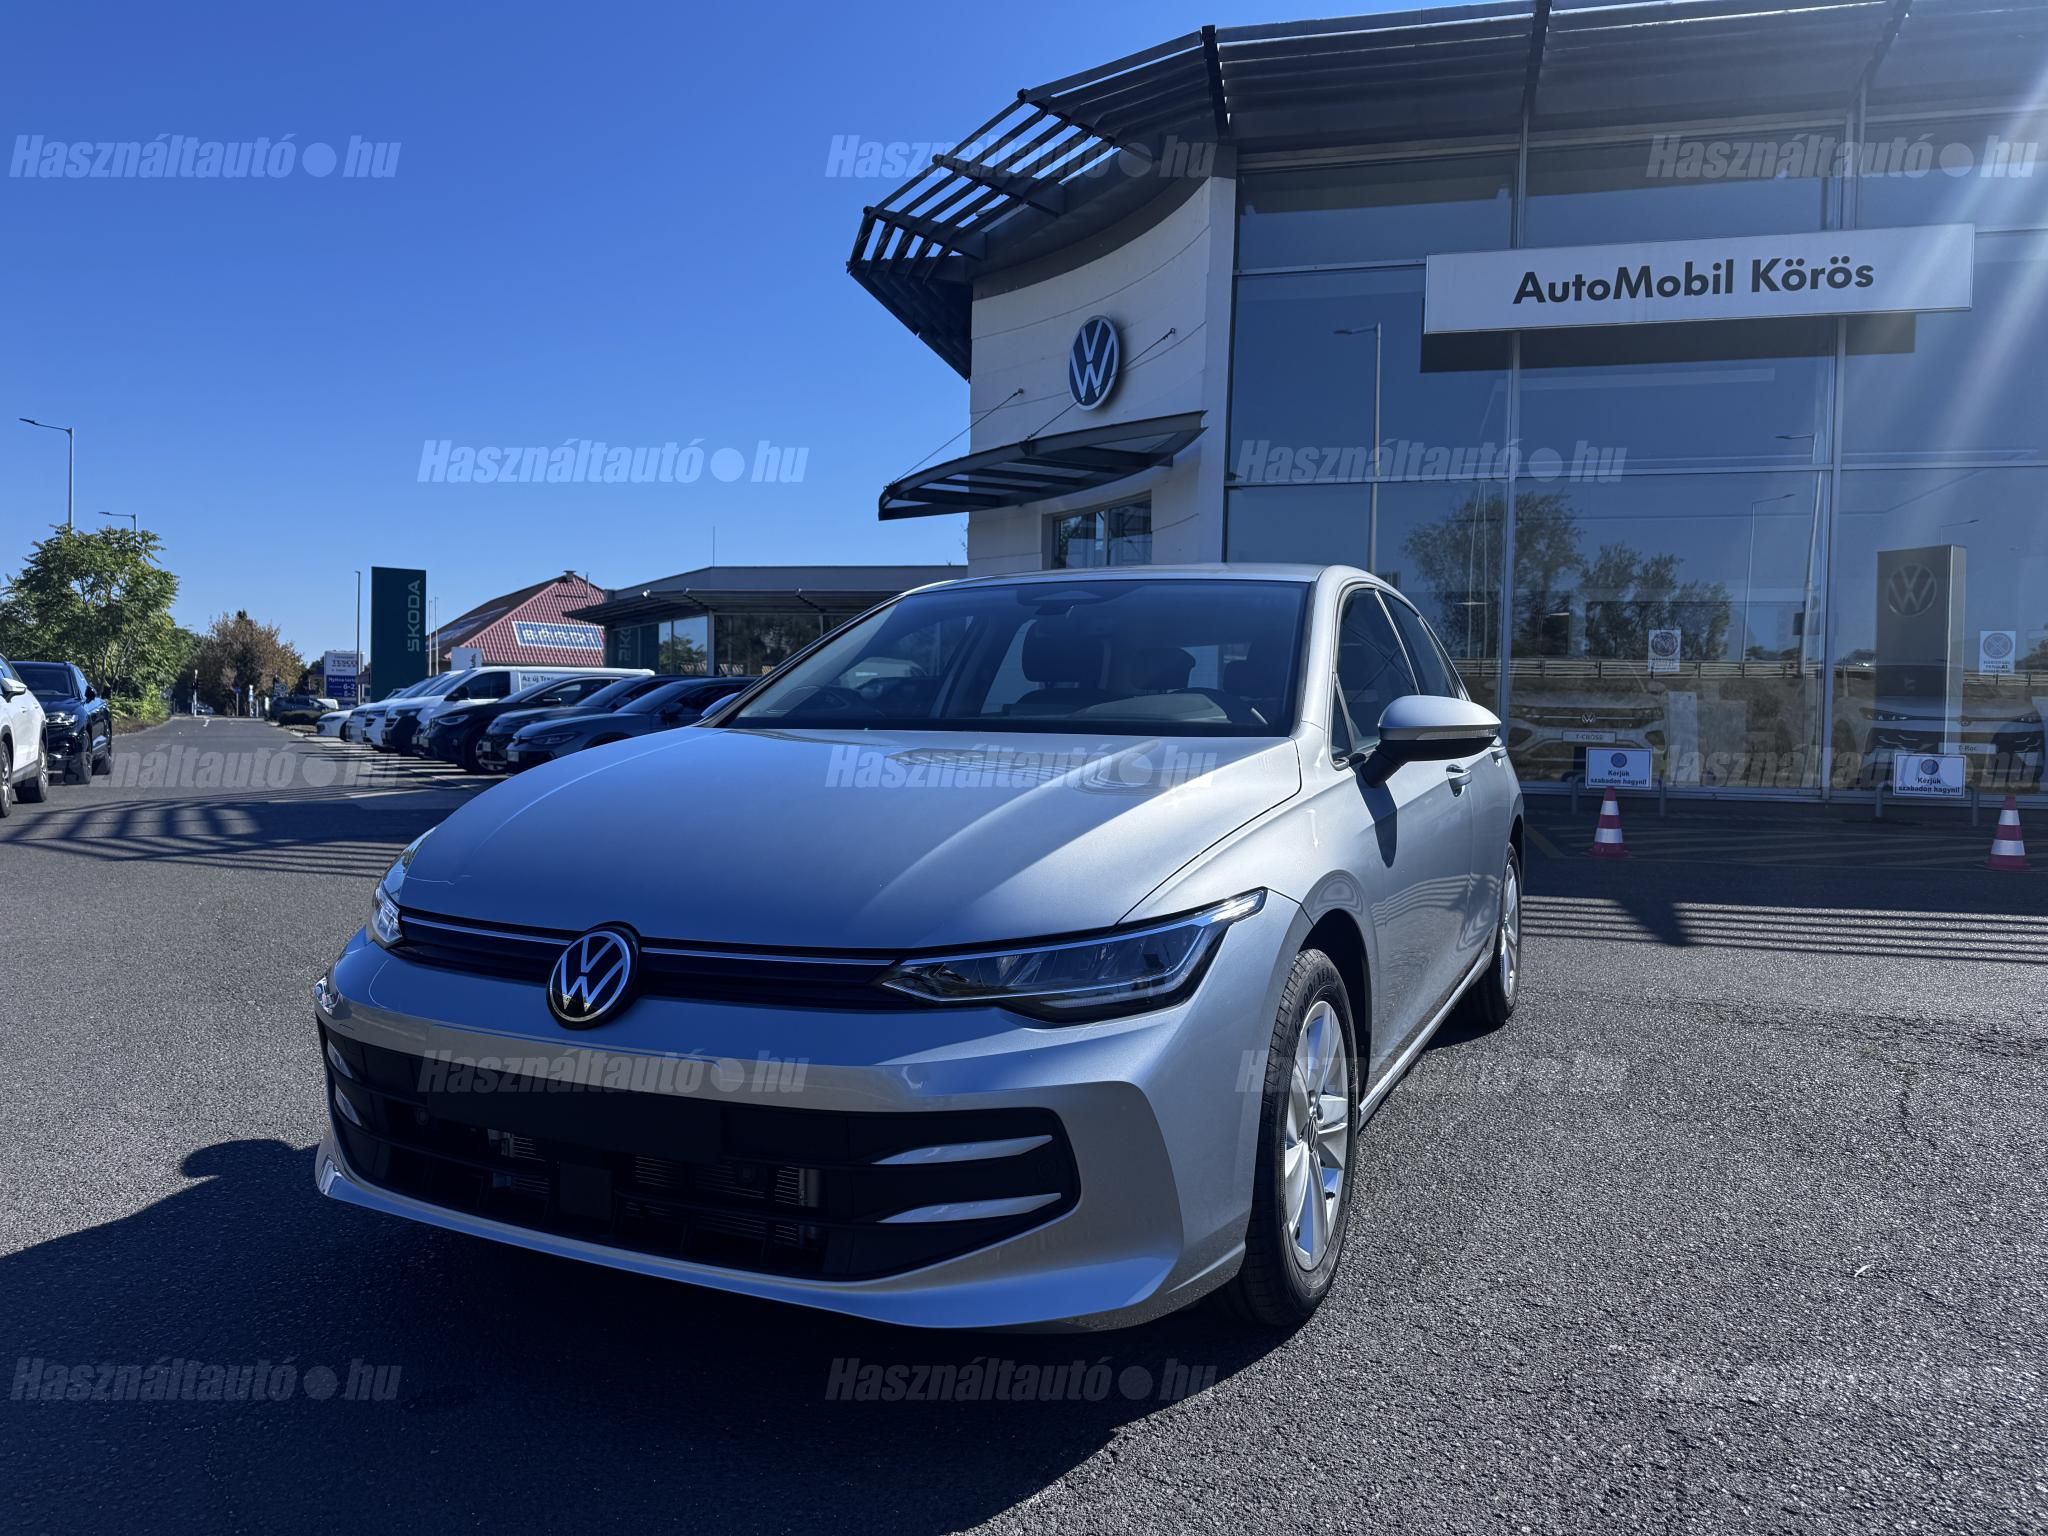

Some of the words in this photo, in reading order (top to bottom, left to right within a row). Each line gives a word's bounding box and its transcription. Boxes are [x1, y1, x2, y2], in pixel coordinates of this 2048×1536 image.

[1513, 260, 1734, 305] AutoMobil
[1752, 255, 1875, 293] Körös
[1917, 777, 1941, 785] Kérjük
